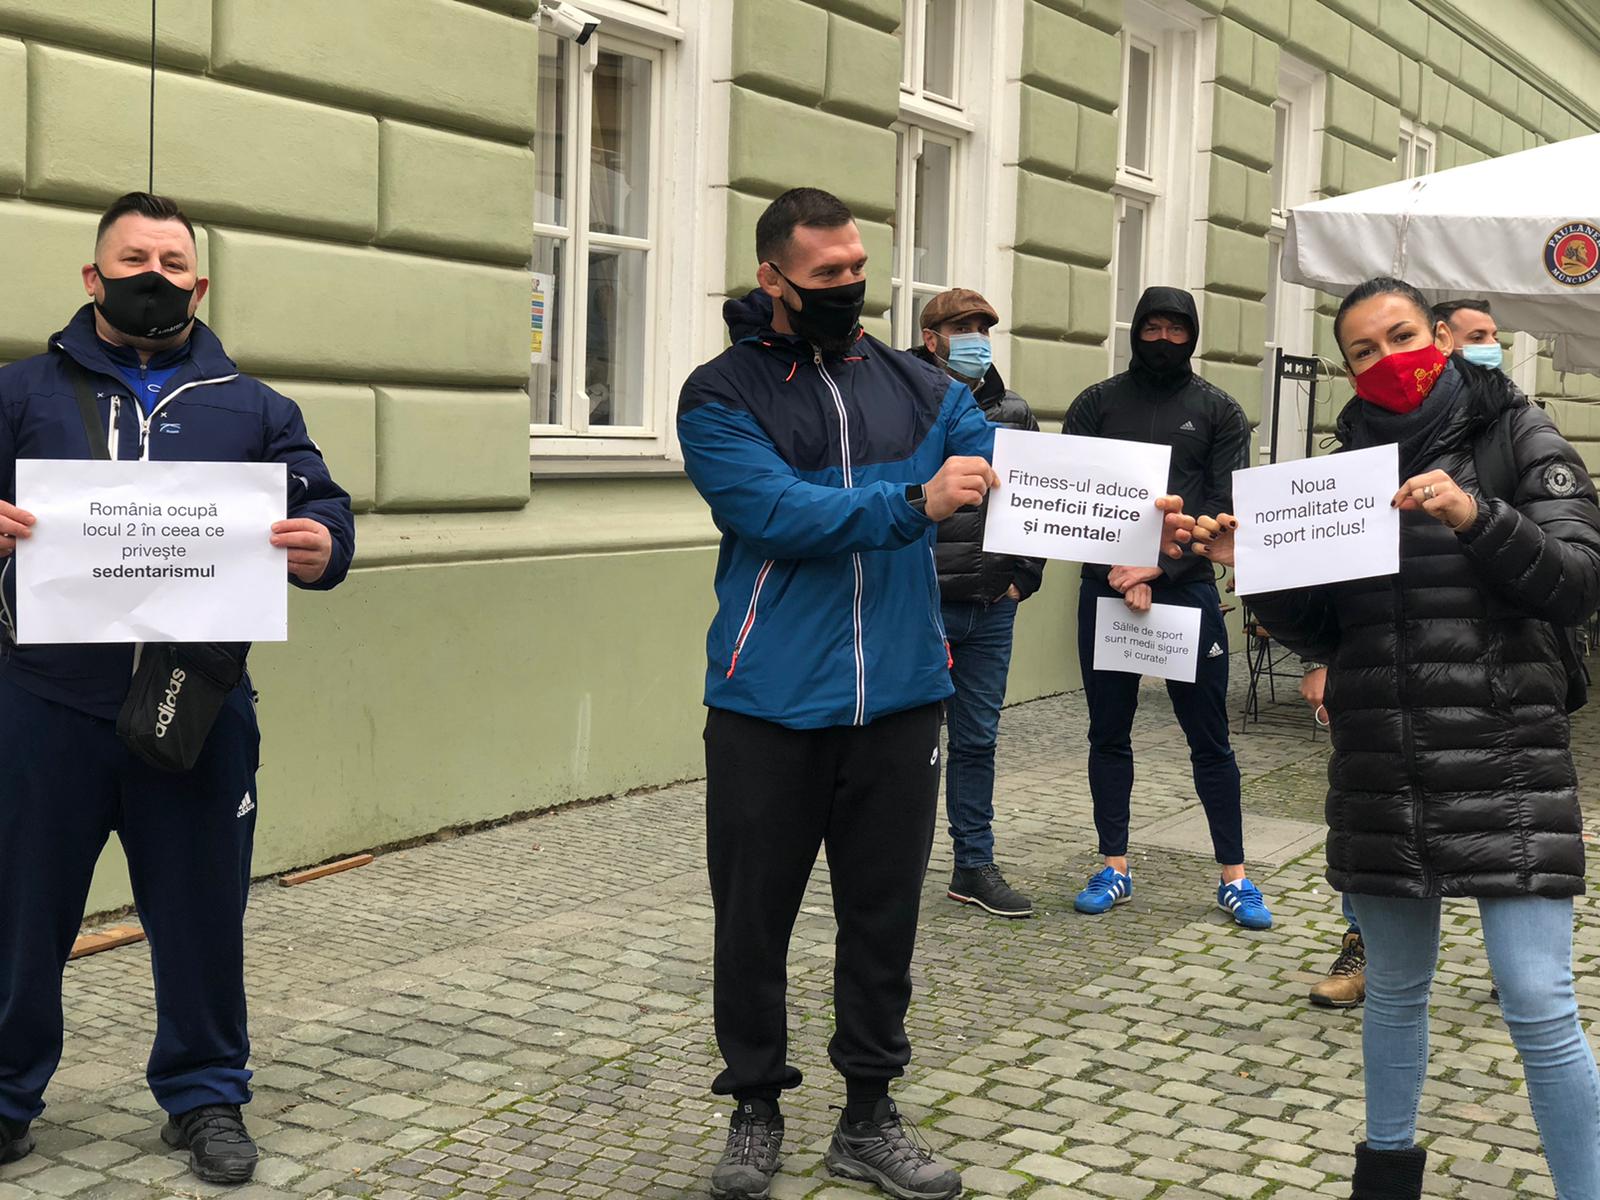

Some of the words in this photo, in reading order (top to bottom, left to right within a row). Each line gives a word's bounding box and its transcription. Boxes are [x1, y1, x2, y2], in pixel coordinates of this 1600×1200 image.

[1009, 469, 1091, 493] Fitness-ul
[1096, 482, 1149, 500] aduce
[1291, 477, 1336, 495] Noua
[90, 502, 162, 516] România
[167, 503, 218, 519] ocupă
[1010, 493, 1088, 515] beneficii
[1092, 503, 1140, 522] fizice
[1255, 499, 1348, 524] normalitate
[1354, 496, 1375, 510] cu
[83, 522, 121, 537] locul
[126, 523, 136, 537] 2
[141, 522, 156, 536] în
[161, 526, 200, 537] ceea
[205, 526, 225, 537] ce
[1043, 522, 1121, 543] mentale!
[1263, 526, 1306, 549] sport
[1311, 517, 1365, 540] inclus!
[92, 564, 215, 578] sedentarismul
[1141, 626, 1154, 636] de
[1156, 630, 1184, 641] sport
[1105, 635, 1127, 644] sunt
[1129, 638, 1156, 650] medii
[1158, 642, 1189, 655] sigure
[1134, 652, 1168, 665] curate!
[155, 667, 187, 738] adidas
